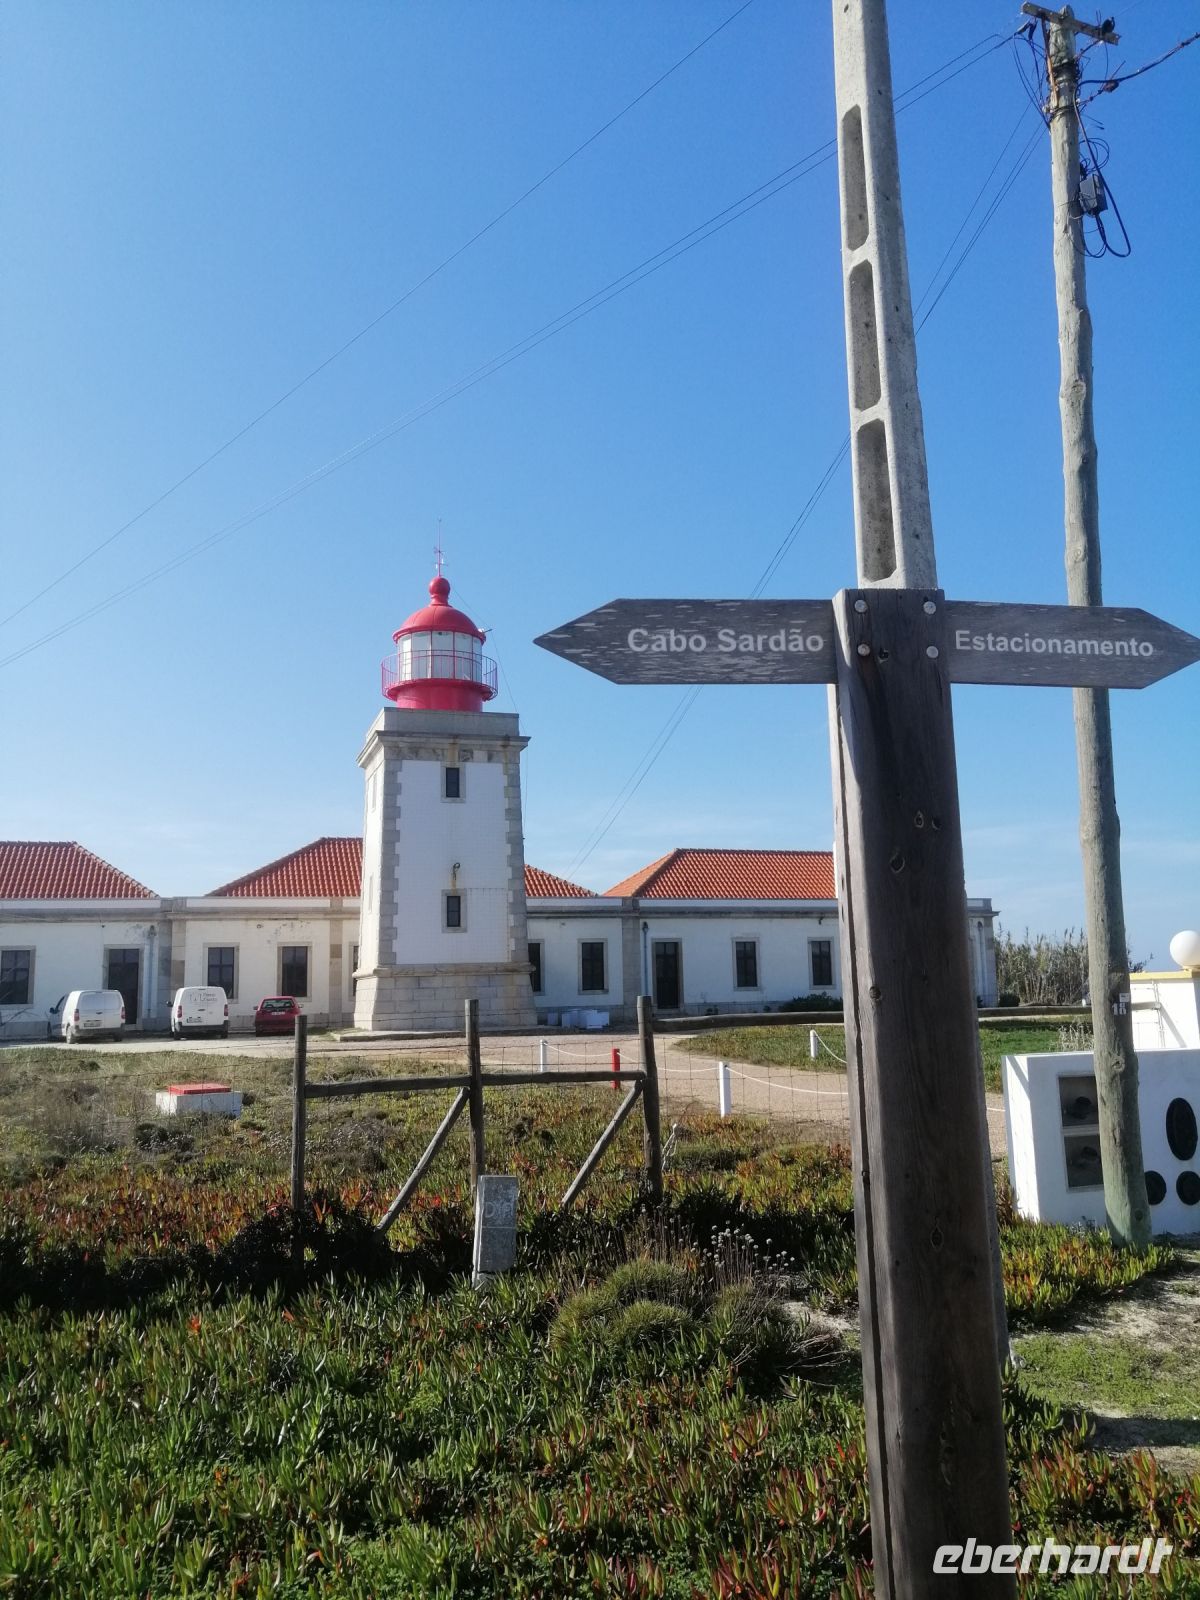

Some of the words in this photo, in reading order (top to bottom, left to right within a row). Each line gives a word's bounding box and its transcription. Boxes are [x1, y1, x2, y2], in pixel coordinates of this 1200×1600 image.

[627, 628, 707, 652] Cabo
[717, 628, 824, 652] Sardão
[955, 630, 1154, 657] Estacionamento
